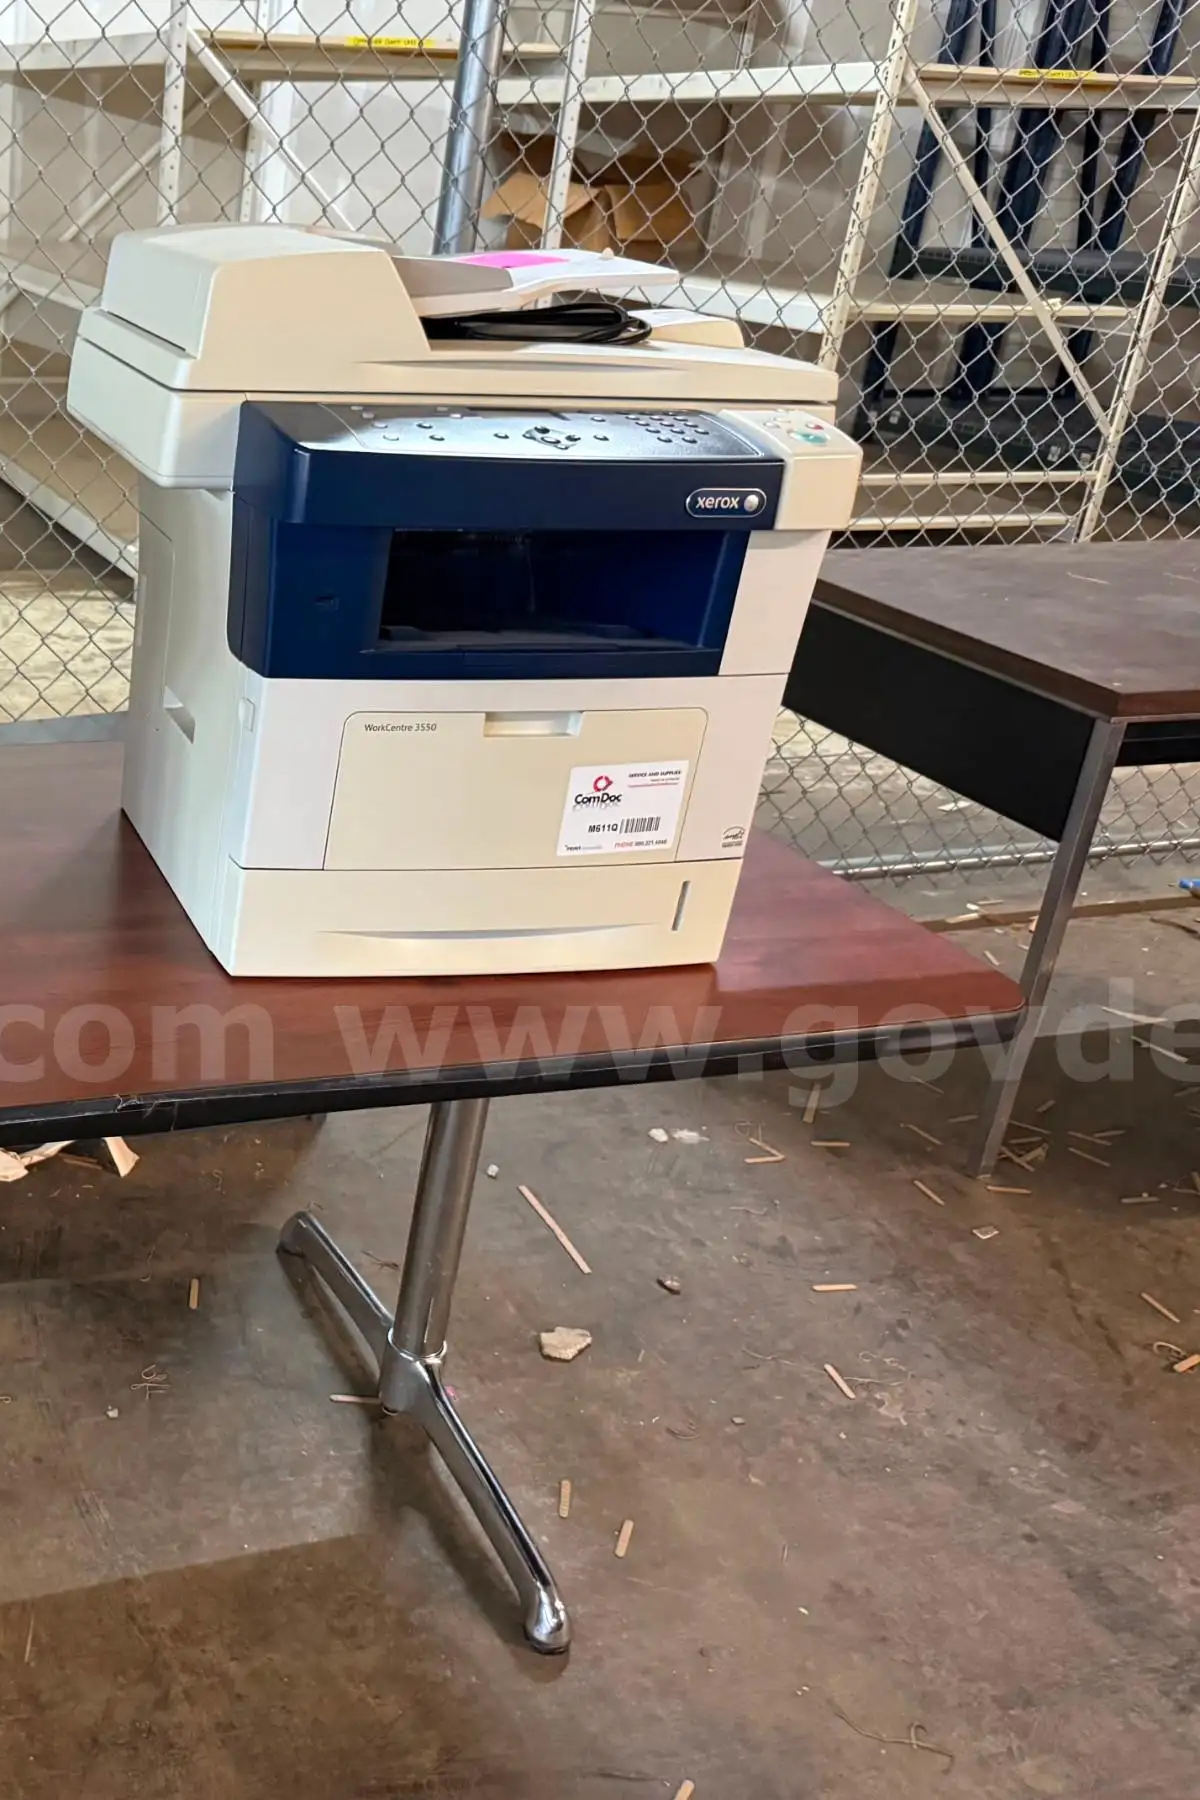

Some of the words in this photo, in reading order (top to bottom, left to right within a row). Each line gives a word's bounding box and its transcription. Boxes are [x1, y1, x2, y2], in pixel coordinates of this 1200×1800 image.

[695, 495, 741, 510] xerox
[364, 722, 413, 733] WorkCentre
[414, 721, 438, 732] 3550
[573, 792, 623, 805] ComDoc
[587, 823, 619, 833] M611Q
